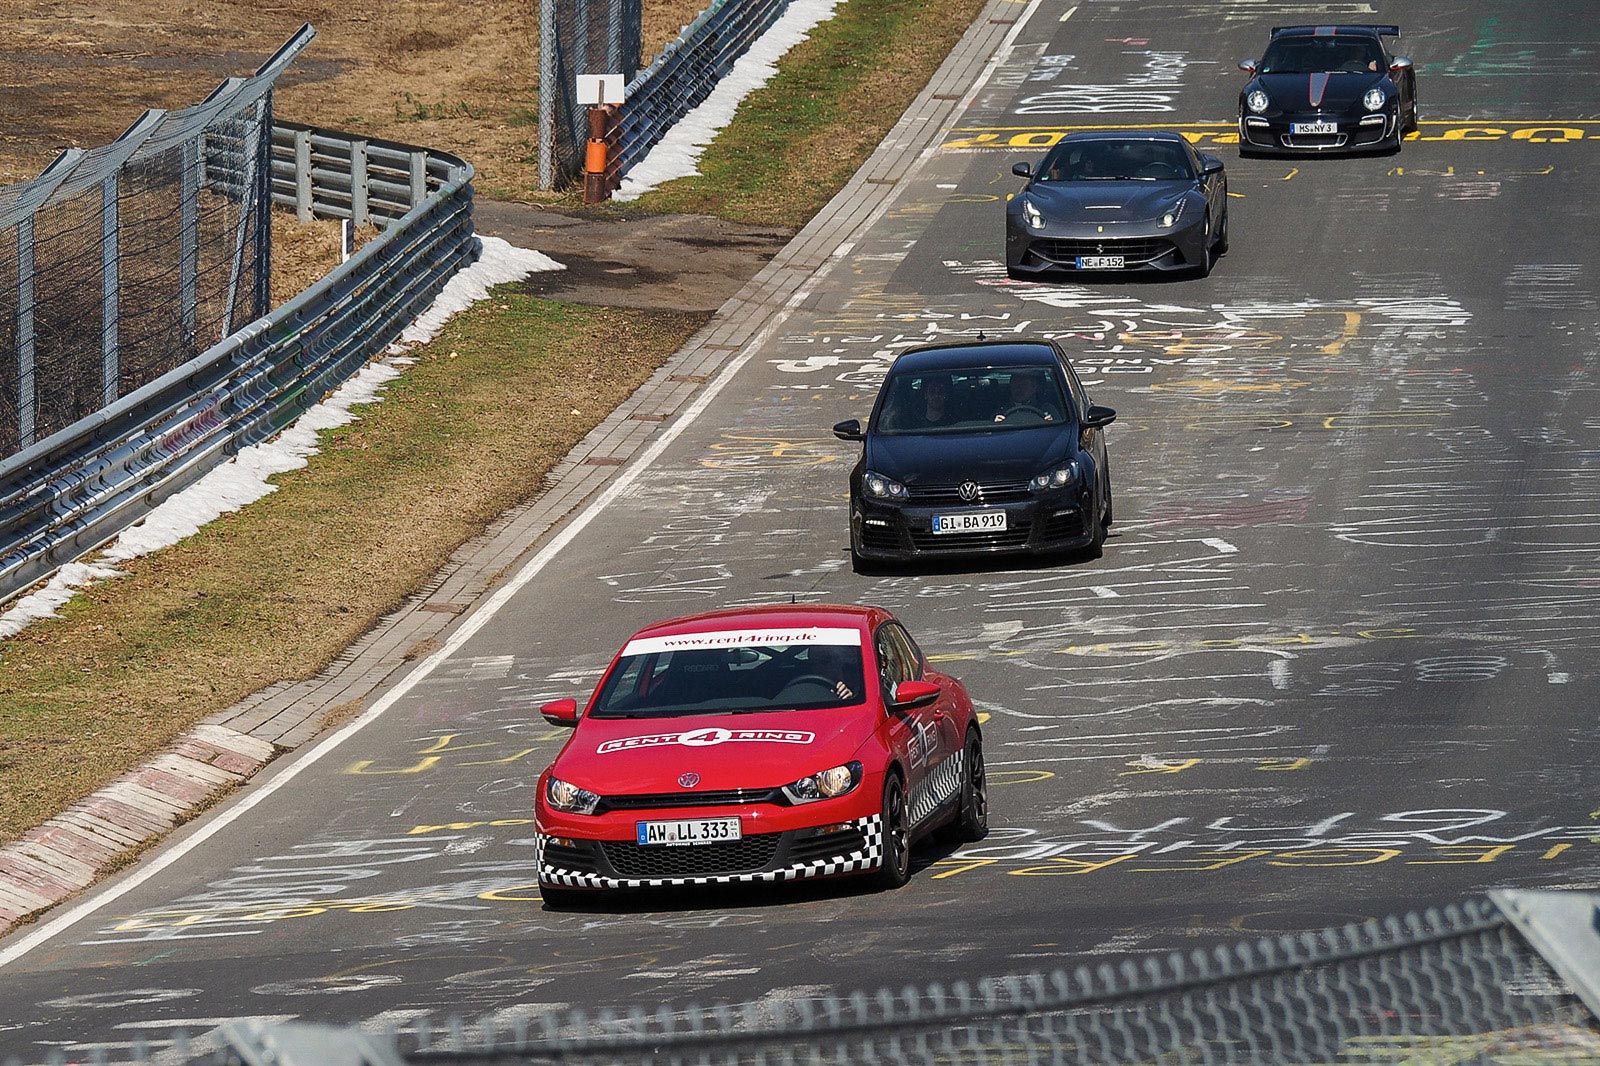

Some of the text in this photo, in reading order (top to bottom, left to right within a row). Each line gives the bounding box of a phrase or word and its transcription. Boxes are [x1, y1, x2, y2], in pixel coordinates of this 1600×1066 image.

[1081, 257, 1123, 267] NE F 152
[940, 514, 1004, 529] GI BA 919
[664, 632, 818, 647] www.rent4ring.de
[606, 730, 804, 749] RENT 4 RING
[648, 825, 666, 841] AW
[677, 823, 697, 840] LL
[700, 821, 729, 839] 333
